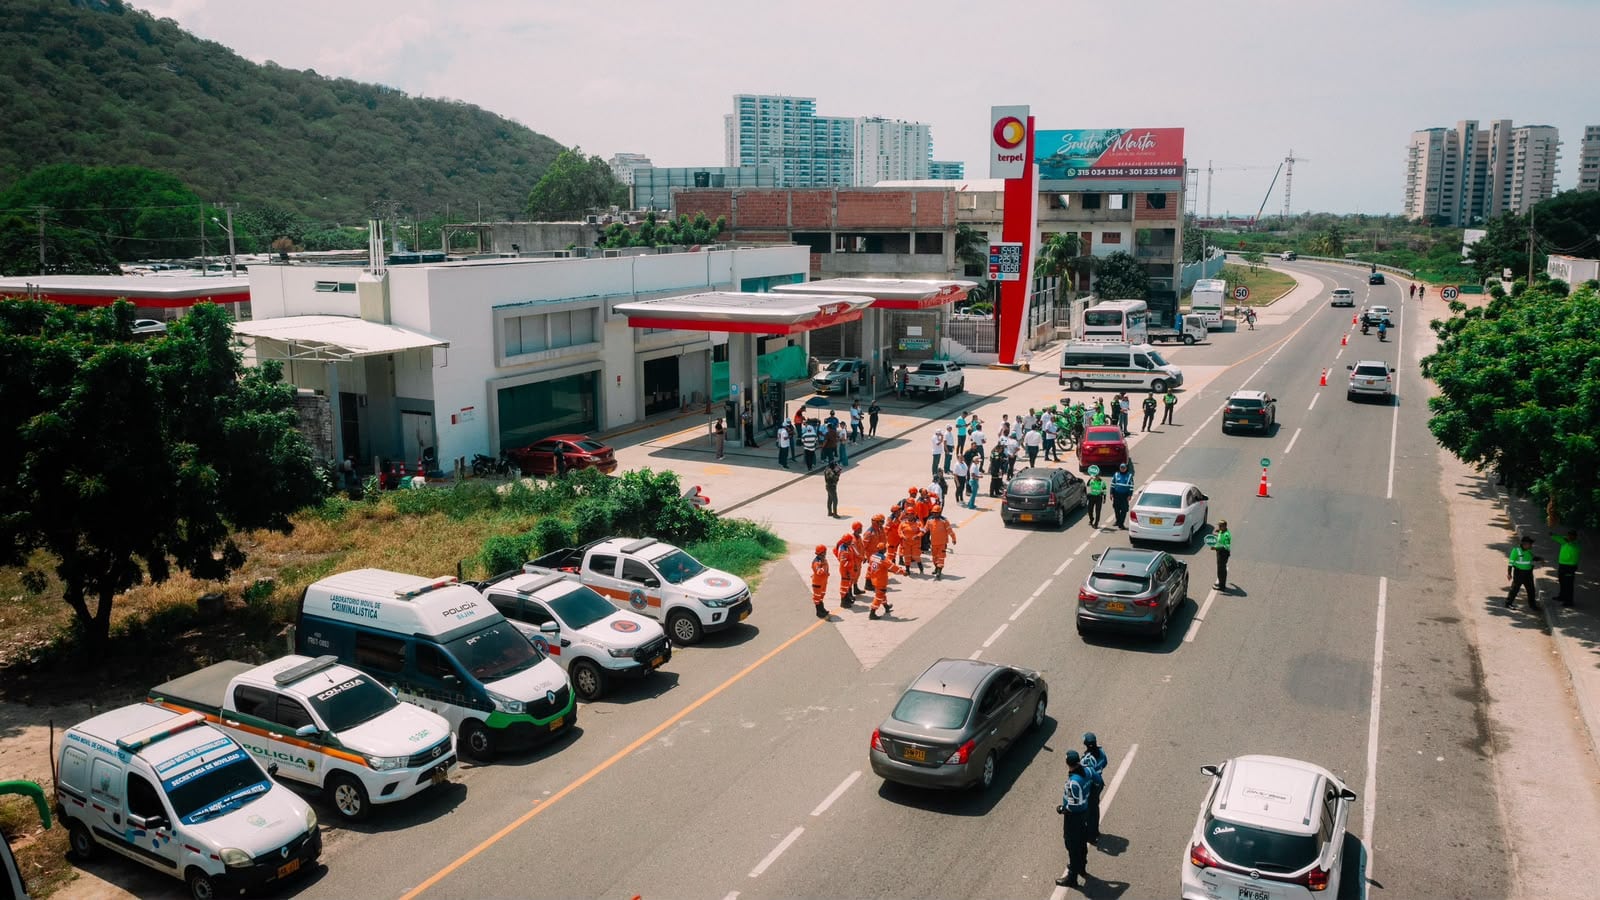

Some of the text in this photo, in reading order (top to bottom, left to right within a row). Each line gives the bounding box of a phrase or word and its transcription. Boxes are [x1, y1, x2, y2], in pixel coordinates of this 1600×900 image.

[1057, 132, 1156, 154] Santa Marta
[997, 153, 1024, 163] terpel
[1107, 168, 1124, 176] 1314
[1236, 289, 1247, 298] 50
[1444, 289, 1456, 299] 50
[330, 594, 360, 605] LABORATORIO
[205, 762, 214, 770] DE
[213, 753, 240, 768] MOVILIDAD
